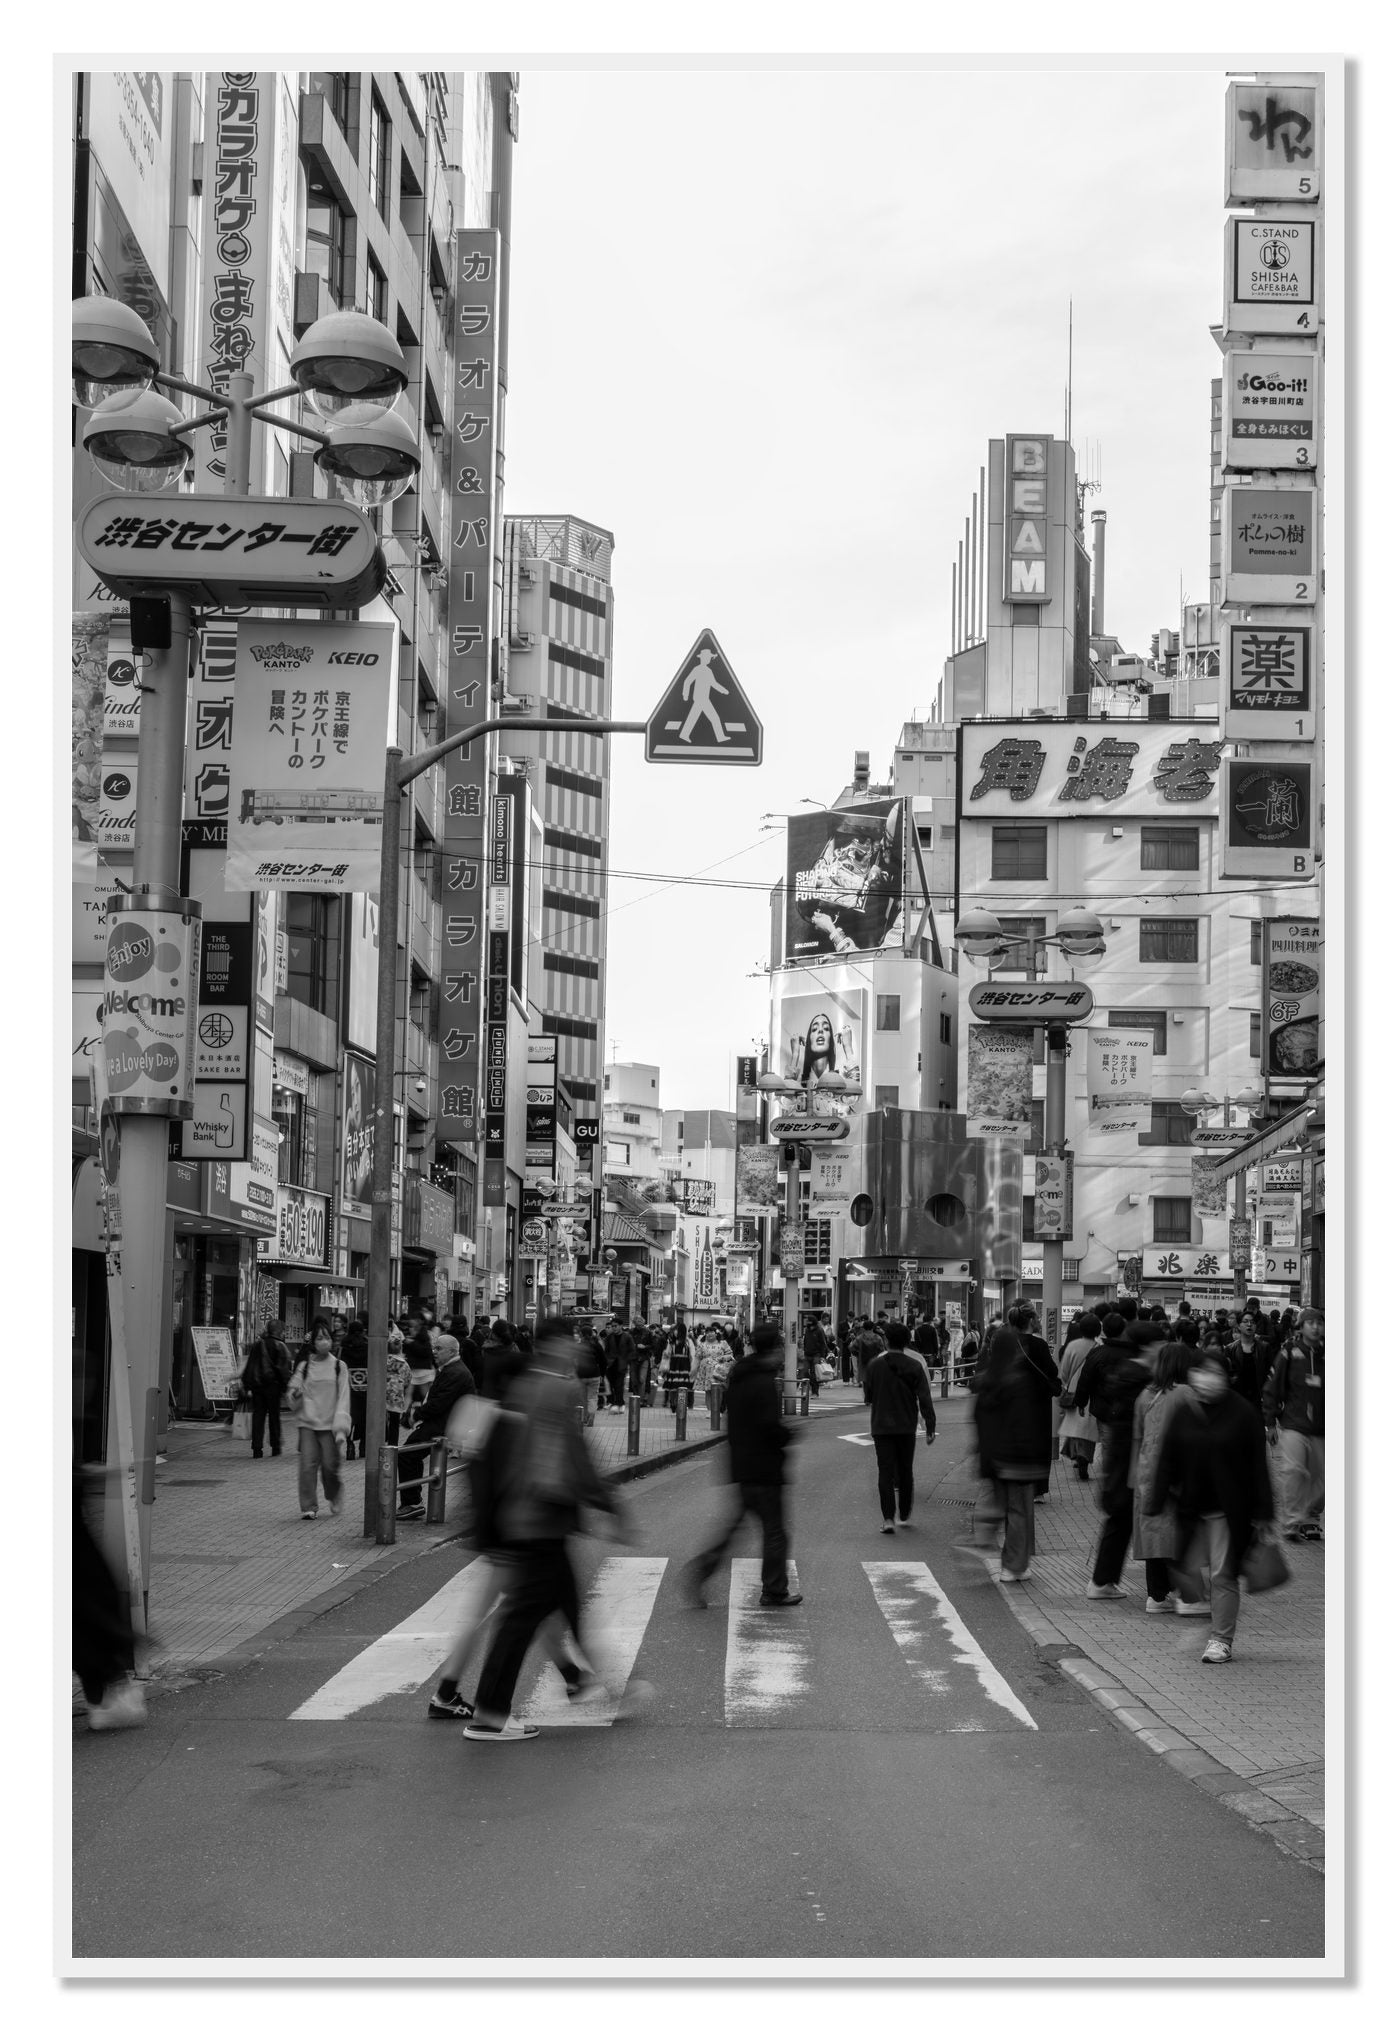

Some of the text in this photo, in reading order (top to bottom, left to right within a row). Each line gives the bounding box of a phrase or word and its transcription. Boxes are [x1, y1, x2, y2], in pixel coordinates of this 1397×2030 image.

[214, 86, 259, 232] カラオケ
[1298, 177, 1311, 194] 5
[1251, 228, 1299, 238] C.STAND
[1251, 271, 1298, 283] SHISHA
[1251, 283, 1298, 293] CAFE&BAR
[1297, 312, 1310, 328] 4
[1249, 375, 1308, 392] Goo-it!
[1242, 396, 1304, 406] 渋谷宇田川町店
[1236, 423, 1309, 435] 全身もみほぐし
[1296, 447, 1309, 465] 3
[1012, 440, 1045, 594] BEAM
[94, 516, 360, 557] 渋谷センター街
[1238, 522, 1306, 543] ポムの樹
[1248, 548, 1297, 556] Pomme-no-ki
[1295, 583, 1308, 599] 2
[263, 660, 301, 669] KANTO
[327, 652, 380, 667] KEIO
[1241, 634, 1295, 689] 薬
[1235, 692, 1301, 707] マツモトキヨシ
[268, 689, 286, 736] 冒険へ
[108, 719, 135, 729] 渋谷店
[287, 690, 308, 769] カントーの
[309, 690, 329, 770] ポケパーク
[332, 691, 351, 755] 京王線で
[1295, 719, 1303, 736] 1
[969, 737, 1226, 801] 角海老
[1235, 778, 1300, 830] 一蘭
[496, 800, 507, 838] kimono
[104, 833, 131, 843] 渋谷店
[255, 863, 350, 877] 渋谷センター街
[1293, 855, 1306, 873] B
[107, 935, 151, 974] Enjoy
[206, 973, 229, 981] ROOM
[209, 984, 226, 992] BAR
[442, 860, 479, 1118] カラオケ館
[103, 989, 186, 1017] Welcome
[977, 991, 1086, 1006] 渋谷センター街
[1269, 1001, 1301, 1022] 6F
[134, 1011, 155, 1034] Shibuya
[122, 1050, 154, 1074] Lovely
[155, 1053, 178, 1068] Day!
[199, 1066, 242, 1074] SAKE BAR
[1110, 1054, 1120, 1086] カントーの
[193, 1121, 230, 1135] Whisky
[576, 1125, 598, 1137] GU
[774, 1121, 840, 1132] 渋谷センター街
[193, 1131, 215, 1142] Bank
[1157, 1252, 1221, 1276] 兆楽
[702, 1250, 712, 1296] BEER
[699, 1297, 713, 1305] HALL
